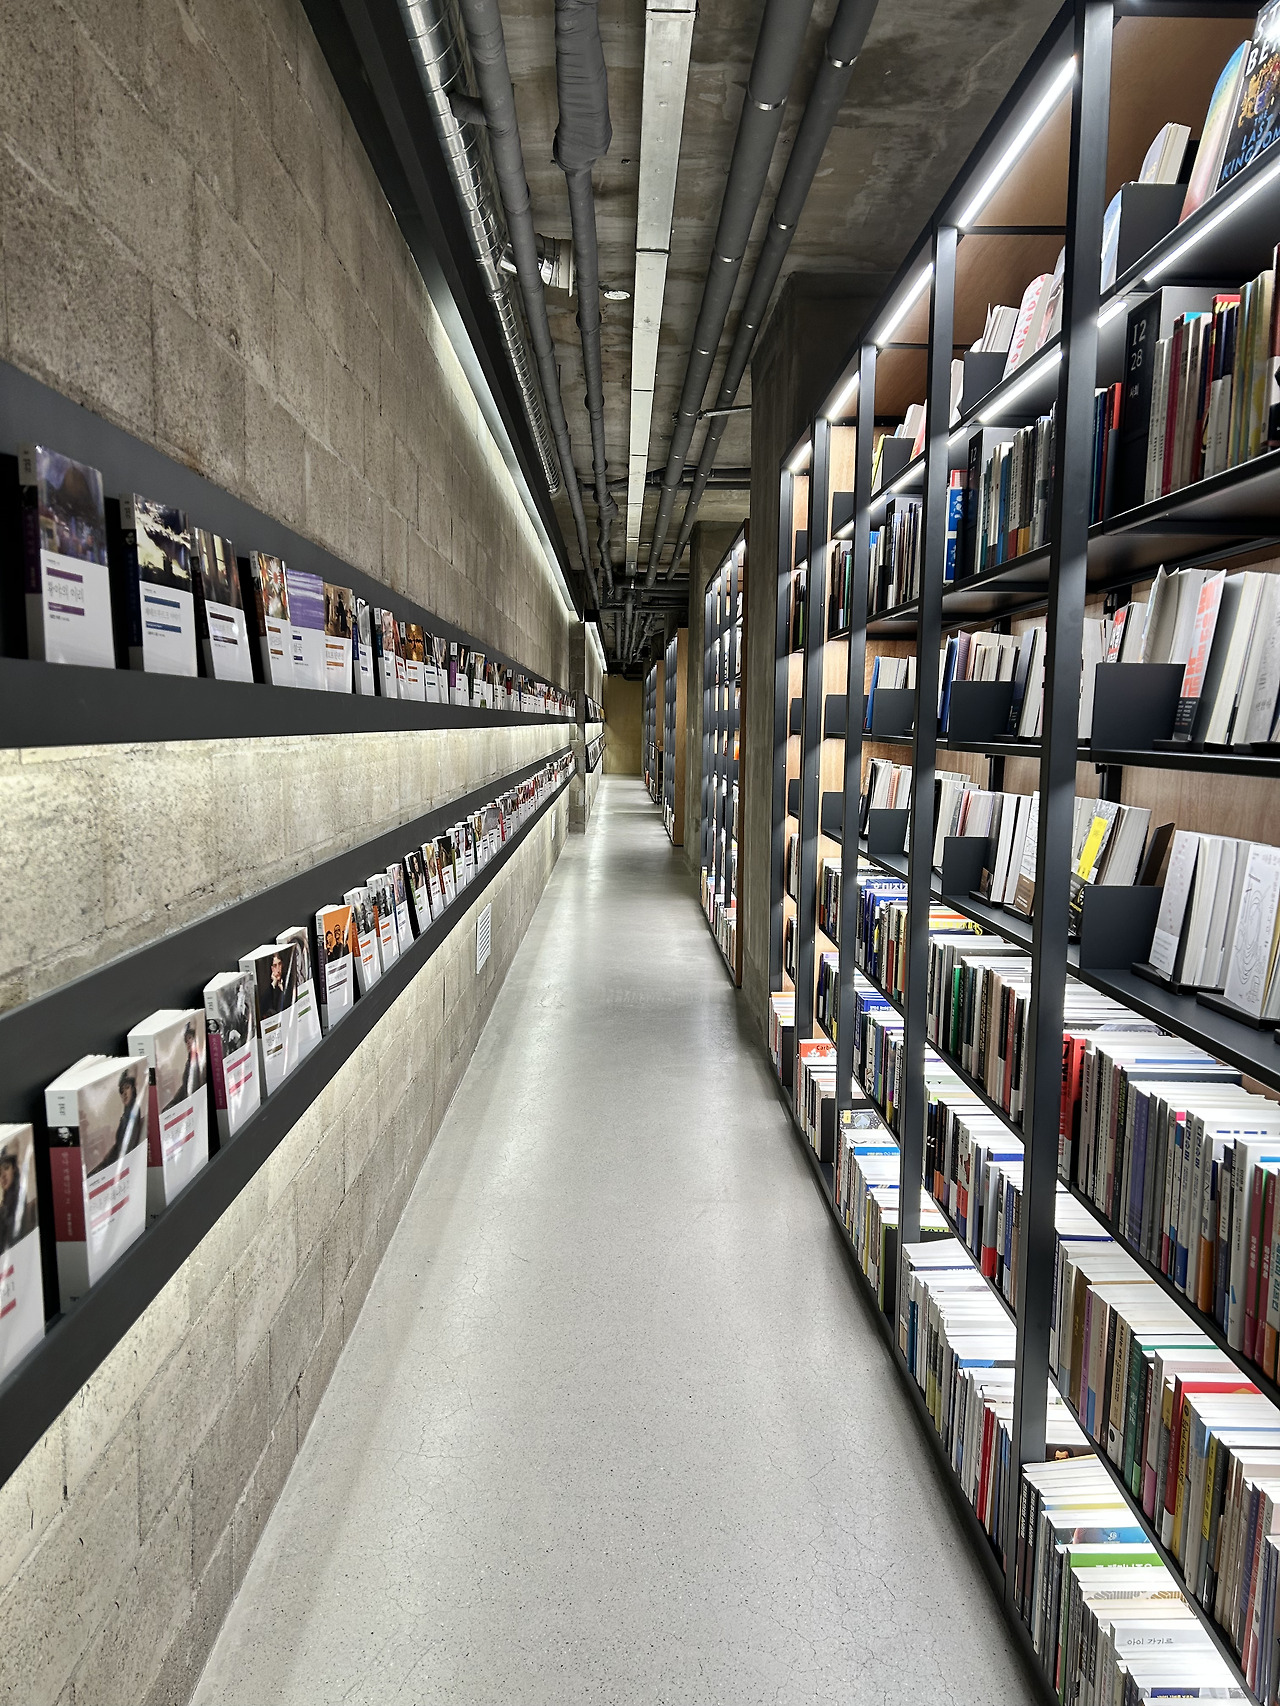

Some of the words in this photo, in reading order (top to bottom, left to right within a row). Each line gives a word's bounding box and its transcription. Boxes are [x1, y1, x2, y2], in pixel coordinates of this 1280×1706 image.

[1254, 110, 1268, 127] THE
[1241, 113, 1273, 150] LAST
[1132, 319, 1147, 346] 12
[1130, 348, 1143, 371] 28
